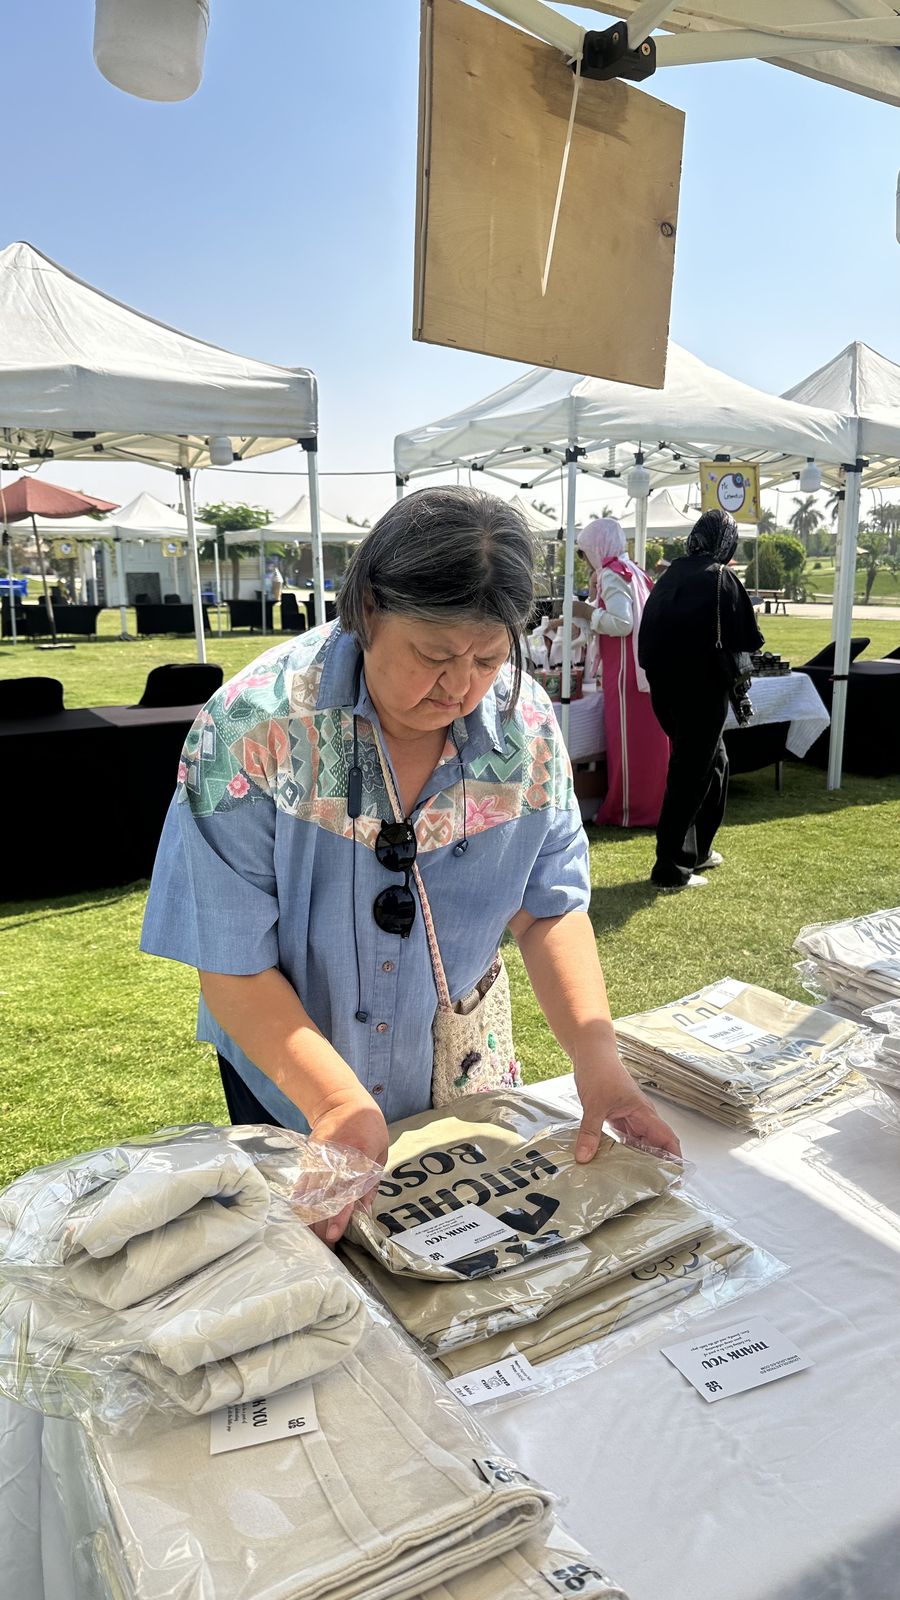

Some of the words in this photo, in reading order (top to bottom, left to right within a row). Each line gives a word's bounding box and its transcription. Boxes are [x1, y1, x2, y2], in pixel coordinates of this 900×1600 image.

[447, 1221, 480, 1237] THANK
[424, 1234, 447, 1246] YOU
[727, 1341, 769, 1360] THANK
[701, 1355, 728, 1369] YOU
[253, 1407, 267, 1428] YOU
